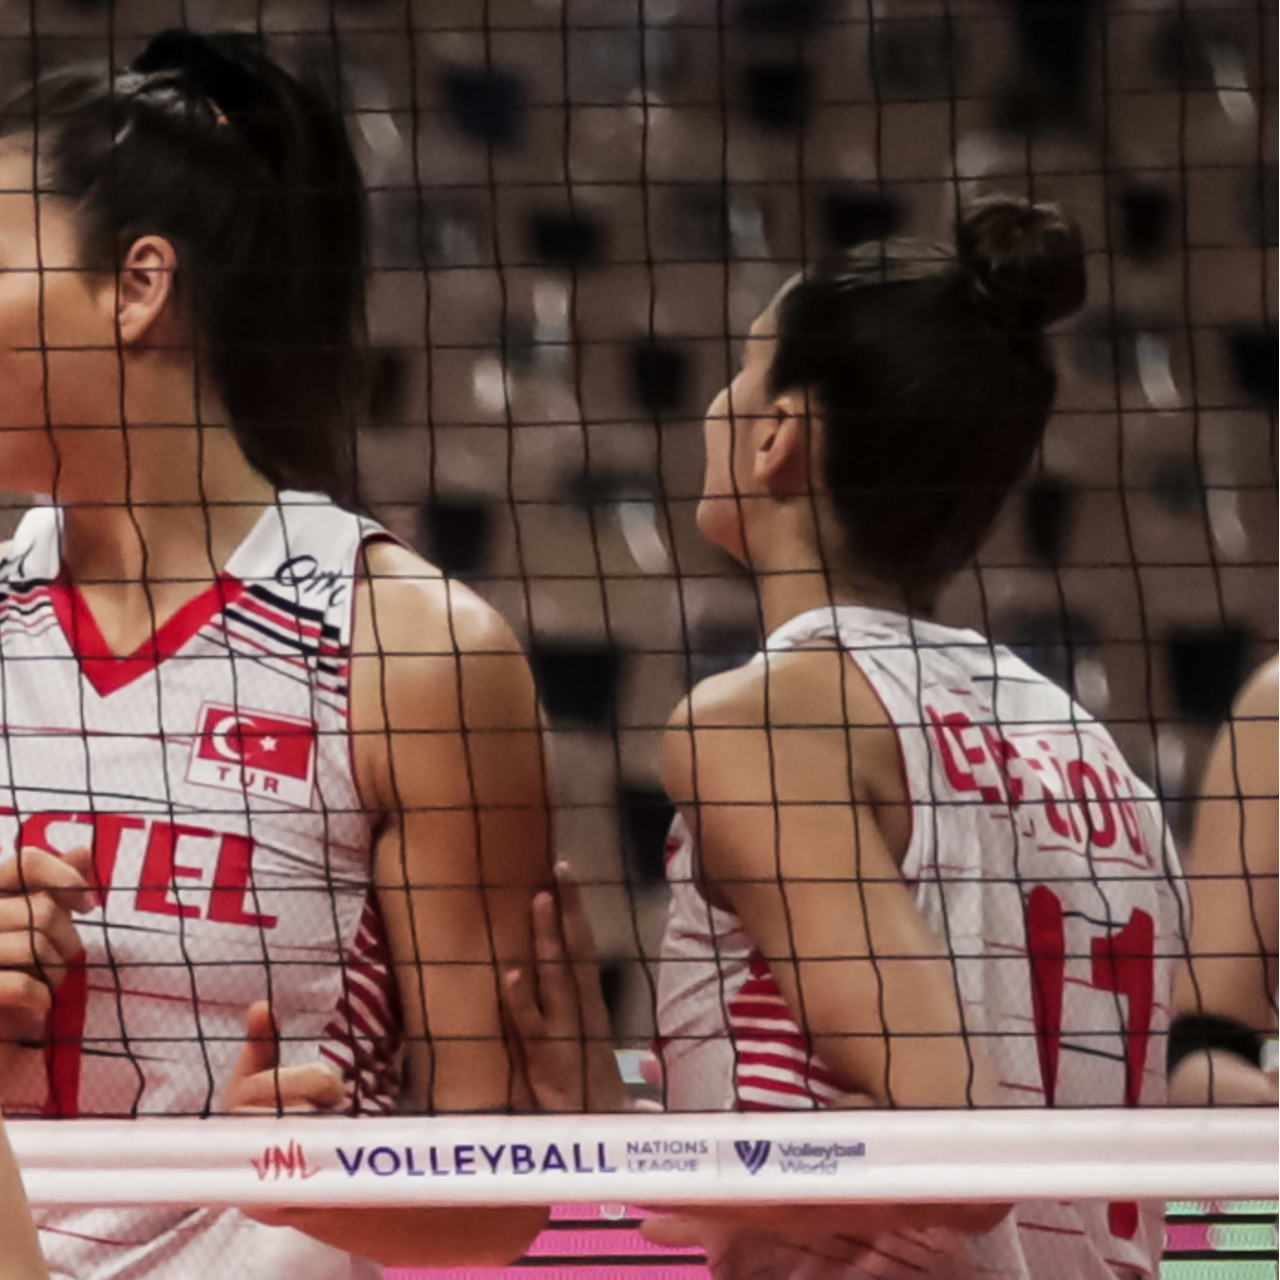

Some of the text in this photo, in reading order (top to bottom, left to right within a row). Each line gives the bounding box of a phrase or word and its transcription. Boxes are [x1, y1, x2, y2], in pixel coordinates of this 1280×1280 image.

[217, 765, 279, 794] TUR
[626, 1140, 709, 1155] NATIONS
[336, 1141, 617, 1178] VOLLEYBALL
[626, 1158, 699, 1173] LEAGUE
